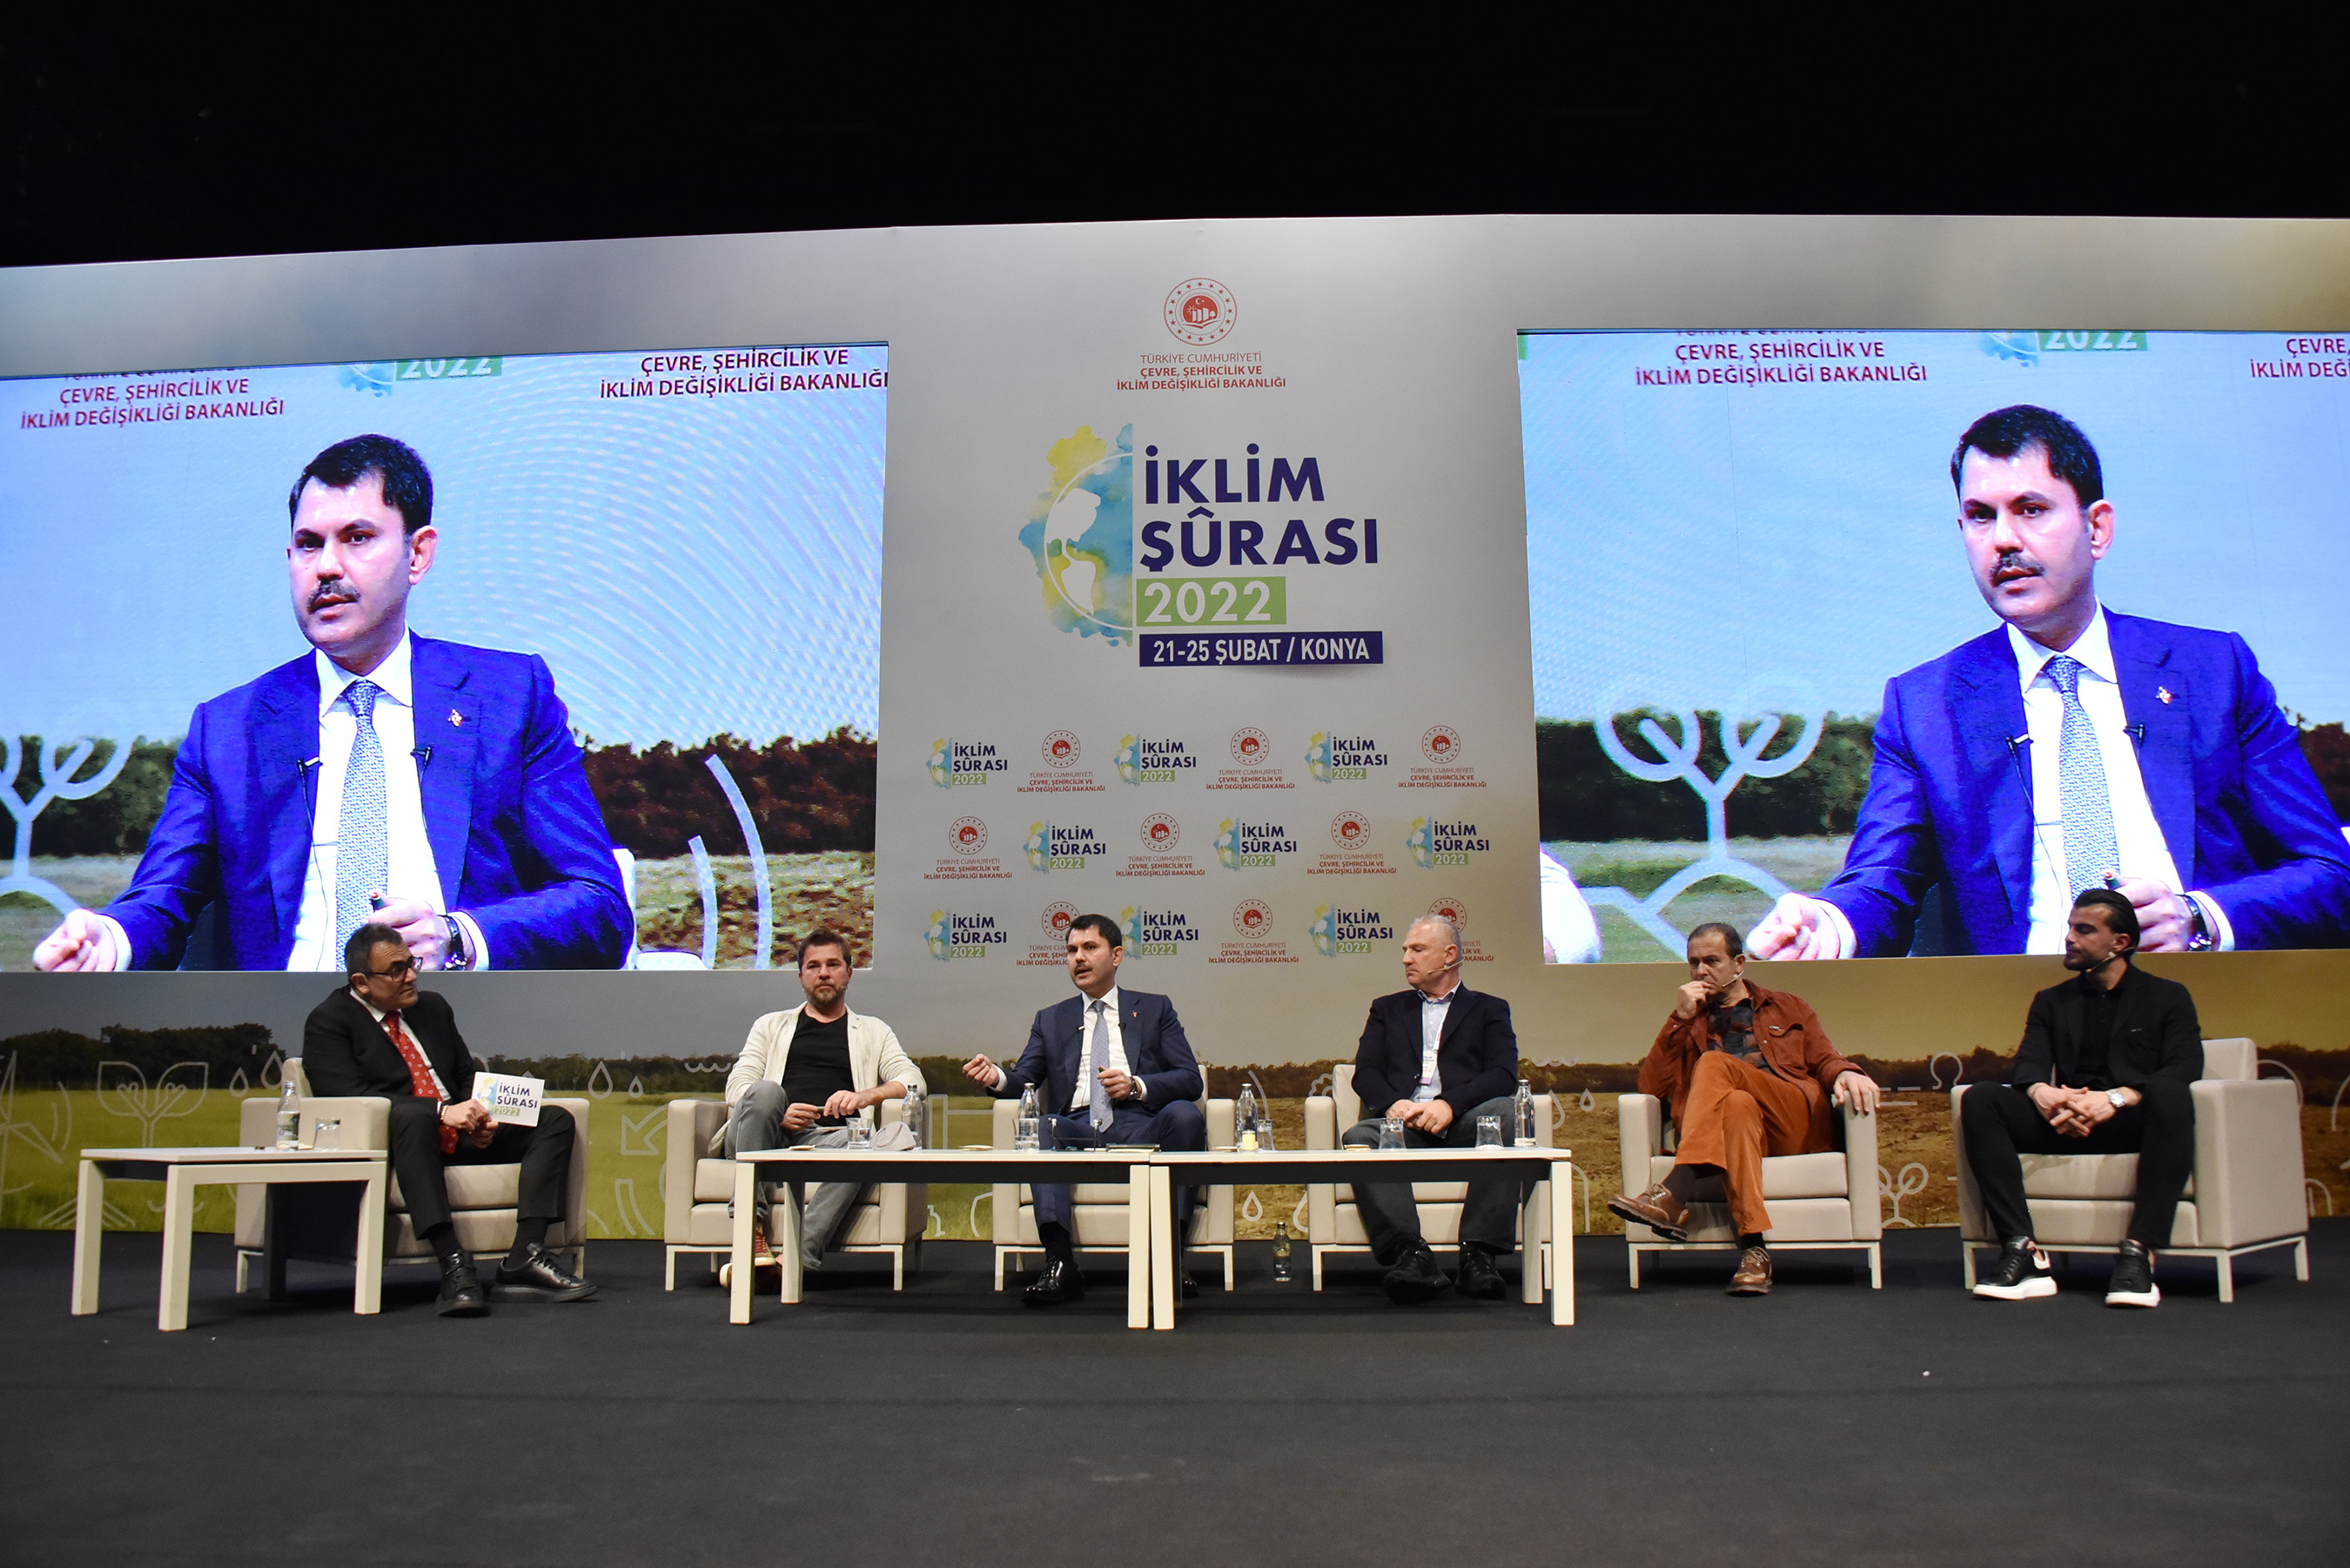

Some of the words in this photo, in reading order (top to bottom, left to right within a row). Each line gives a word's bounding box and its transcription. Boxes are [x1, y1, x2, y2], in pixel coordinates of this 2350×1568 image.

[1140, 352, 1184, 364] TÜRKİYE
[1188, 351, 1262, 363] CUMHURİYETİ
[1675, 344, 1743, 365] ÇEVRE,
[1749, 339, 1856, 362] ŞEHİRCİLİK
[1859, 342, 1884, 357] VE
[641, 355, 707, 377] ÇEVRE,
[713, 347, 819, 373] ŞEHİRCİLİK
[824, 350, 849, 365] VE
[2251, 358, 2302, 378] İKLİM
[1140, 366, 1179, 378] ÇEVRE,
[1183, 365, 1245, 378] ŞEHİRCİLİK
[1248, 366, 1262, 375] VE
[1635, 366, 1691, 386] İKLİM
[1698, 363, 1814, 387] DEĞİŞİKLİĞİ
[1821, 362, 1926, 382] BAKANLIĞI
[60, 386, 118, 406] ÇEVRE,
[125, 377, 222, 404] ŞEHİRCİLİK
[227, 379, 249, 394] VE
[601, 379, 653, 399] İKLİM
[659, 372, 775, 399] DEĞİŞİKLİĞİ
[780, 369, 888, 392] BAKANLIĞI
[1117, 379, 1149, 390] İKLİM
[1152, 378, 1219, 391] DEĞİŞİKLİĞİ
[1223, 377, 1286, 388] BAKANLIĞI
[22, 409, 69, 429] İKLİM
[75, 402, 179, 426] DEĞİŞİKLİĞİ
[185, 397, 284, 420] BAKANLIĞI
[1145, 443, 1325, 504] İKLİM
[1140, 506, 1378, 572] ŞÛRASI
[1144, 580, 1271, 624] 2022
[1153, 640, 1209, 662] 21-25
[1215, 638, 1280, 665] ŞUBAT
[1286, 638, 1295, 662] /
[1301, 638, 1369, 660] KONYA
[954, 742, 996, 757] İKLİM
[1142, 739, 1185, 754] İKLİM
[1333, 736, 1375, 752] İKLİM
[953, 757, 1008, 773] ŞÛRASI
[1141, 754, 1197, 770] ŞÛRASI
[1333, 752, 1387, 767] ŞÛRASI
[953, 774, 983, 785] 2022
[1141, 771, 1172, 781] 2022
[1333, 768, 1363, 780] 2022
[1051, 825, 1094, 840] İKLİM
[1242, 823, 1284, 838] İKLİM
[1434, 821, 1477, 836] İKLİM
[1051, 841, 1106, 856] ŞÛRASI
[1241, 838, 1297, 853] ŞÛRASI
[1434, 836, 1489, 852] ŞÛRASI
[1051, 858, 1081, 868] 2022
[1242, 855, 1272, 866] 2022
[1435, 854, 1465, 865] 2022
[952, 914, 995, 928] İKLİM
[1143, 910, 1186, 926] İKLİM
[1337, 908, 1380, 924] İKLİM
[951, 928, 1007, 945] ŞÛRASI
[1143, 926, 1198, 941] ŞÛRASI
[1337, 924, 1393, 941] ŞÛRASI
[952, 947, 982, 957] 2022
[1143, 944, 1174, 955] 2022
[1338, 942, 1368, 953] 2022
[500, 1082, 530, 1096] İKLİM
[495, 1107, 518, 1116] 2022
